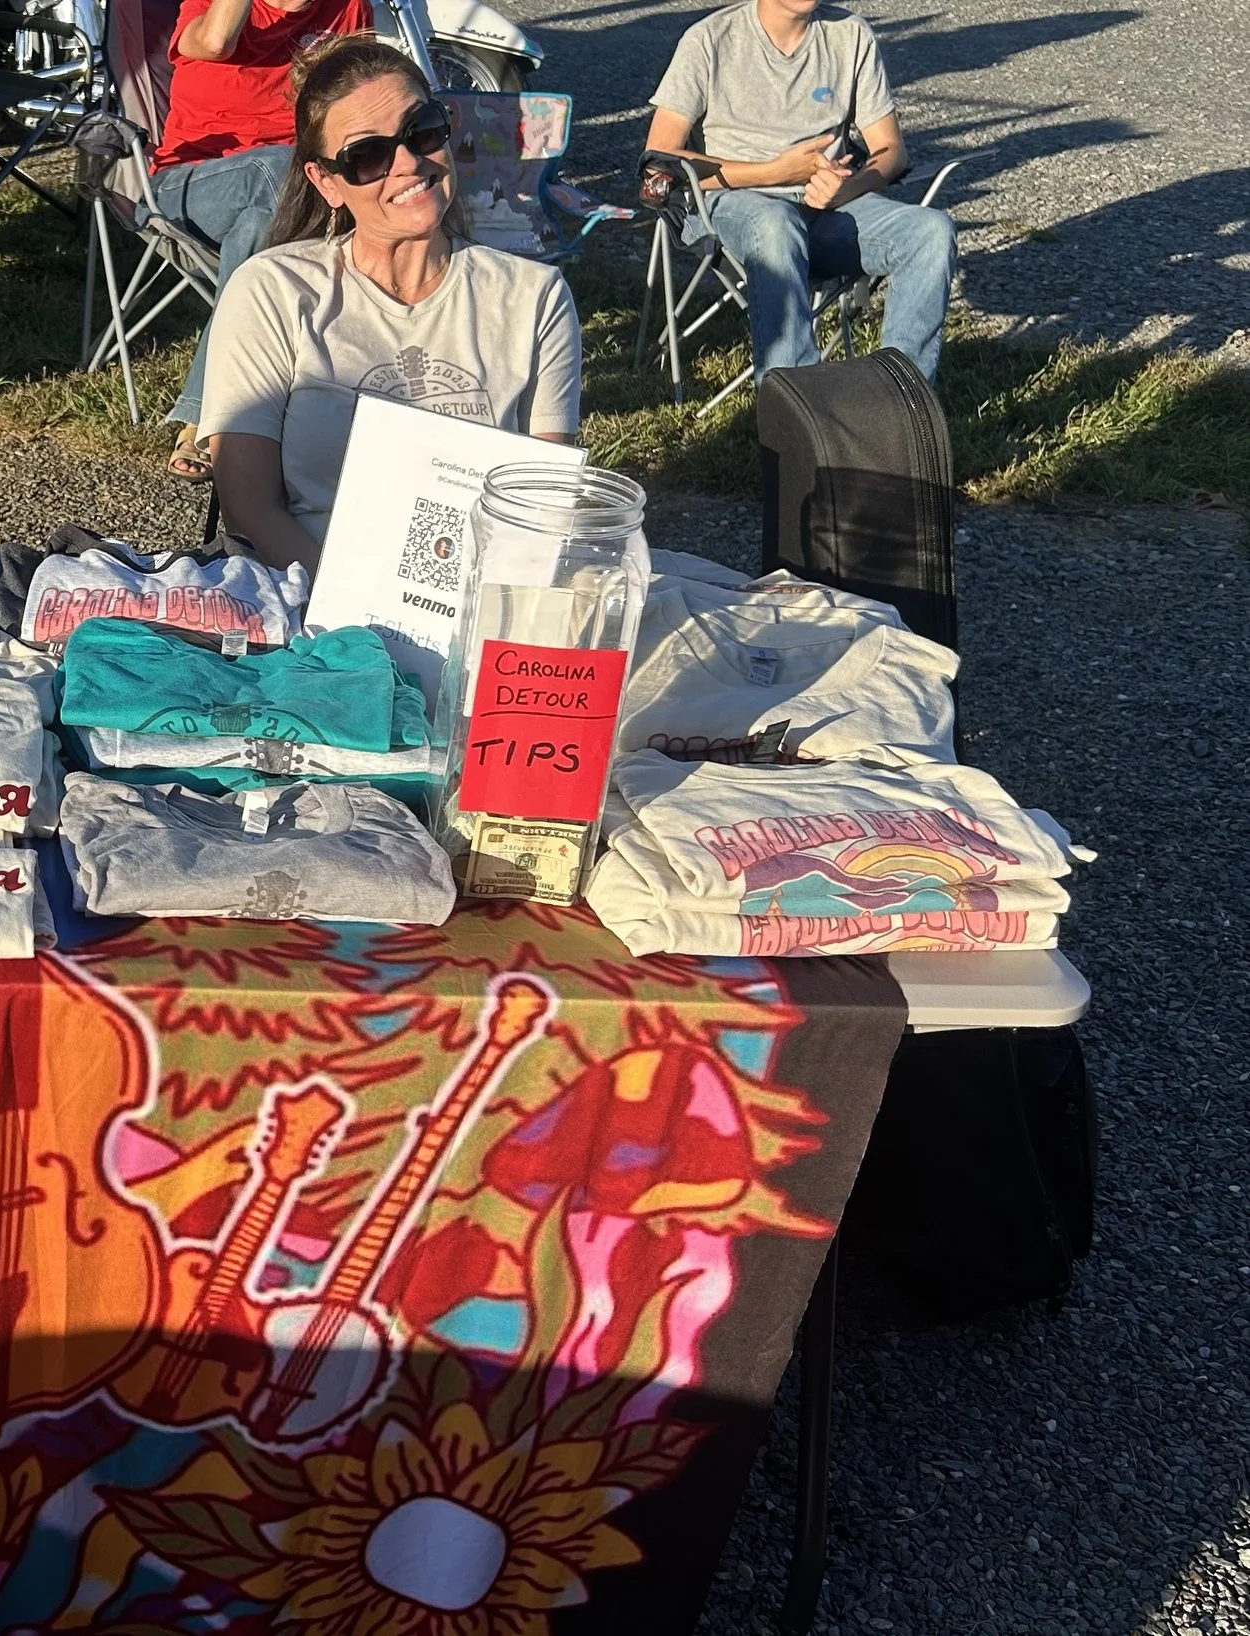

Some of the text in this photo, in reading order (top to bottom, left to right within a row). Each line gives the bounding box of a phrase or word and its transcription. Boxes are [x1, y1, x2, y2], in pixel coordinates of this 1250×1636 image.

[369, 365, 471, 389] ESTD 2023
[432, 402, 490, 416] DETOUR
[431, 457, 467, 474] Carolina
[402, 591, 456, 618] venmo
[365, 612, 441, 654] T-Shirts
[495, 650, 596, 681] CAROLINA
[496, 685, 589, 710] DETOUR
[471, 738, 580, 773] TIPS
